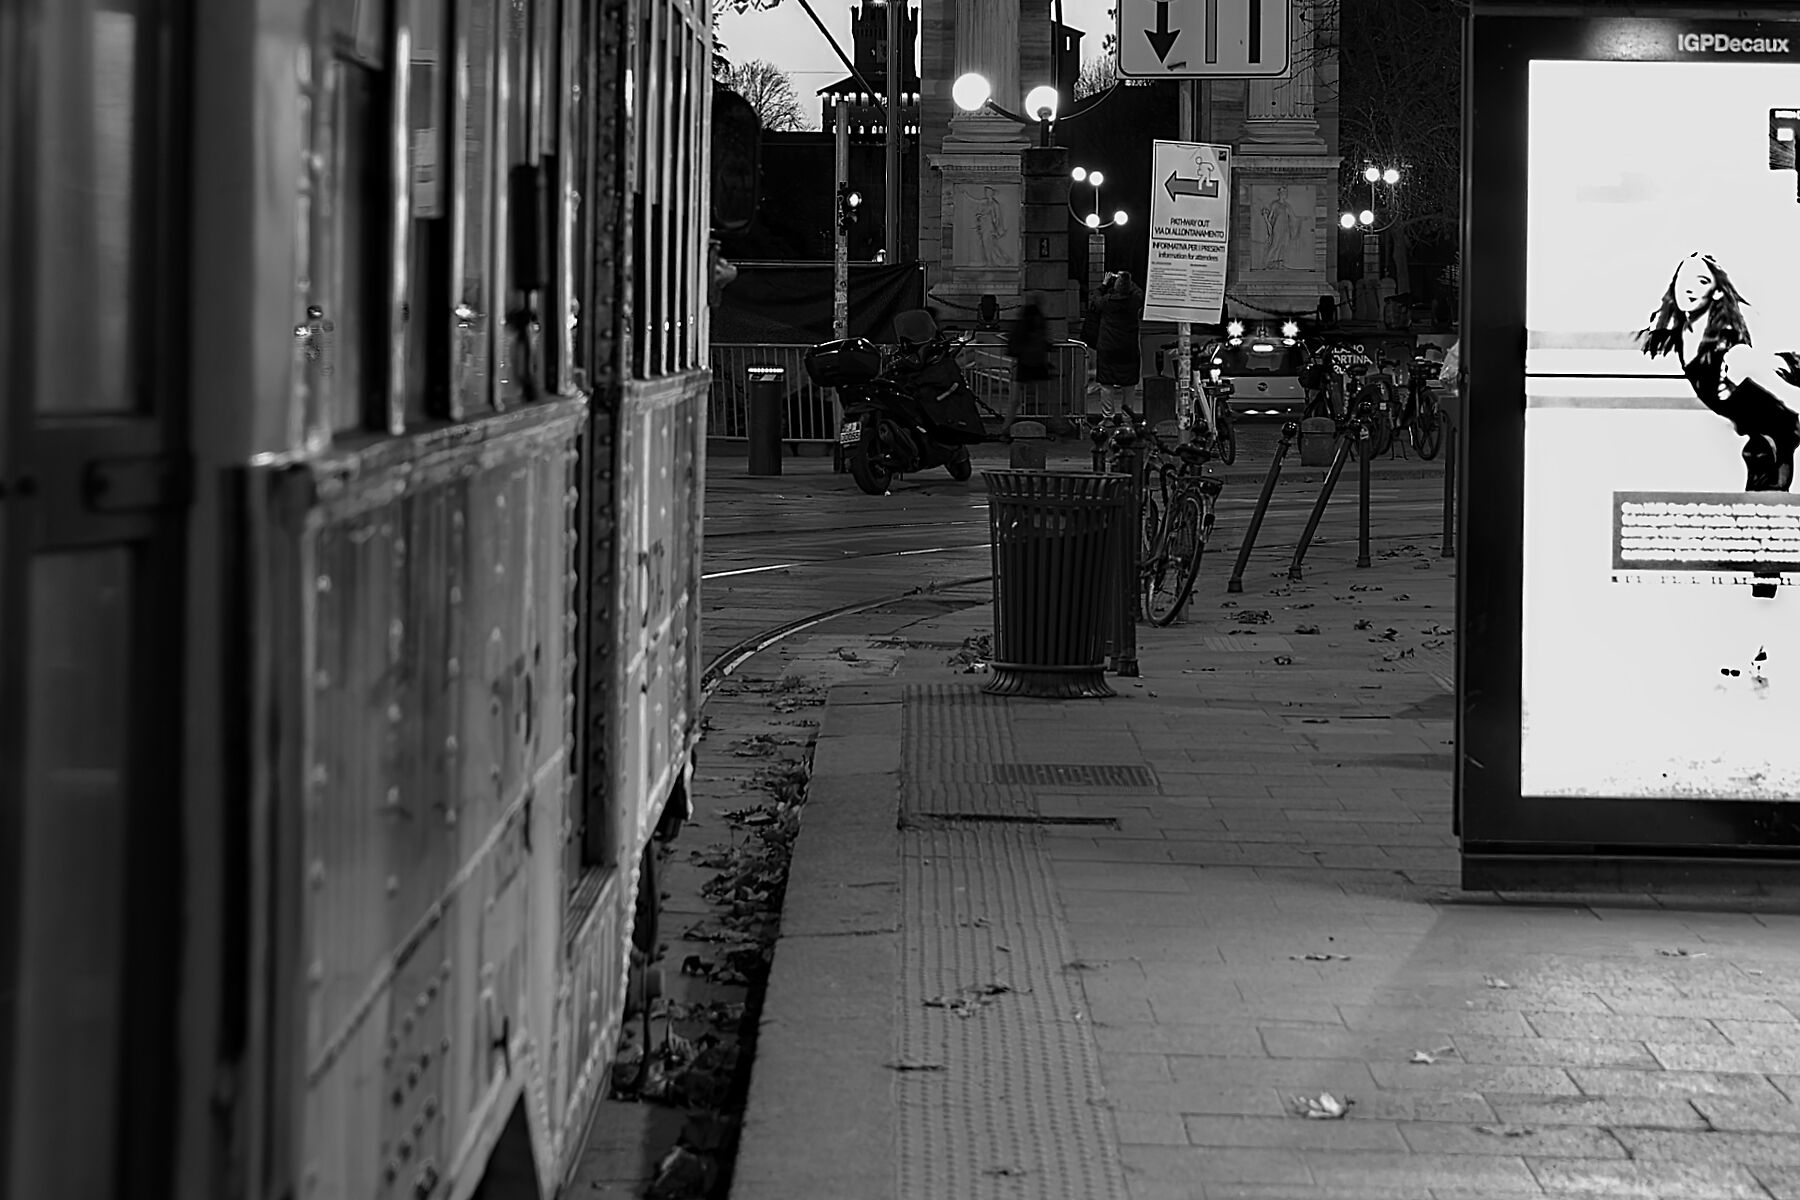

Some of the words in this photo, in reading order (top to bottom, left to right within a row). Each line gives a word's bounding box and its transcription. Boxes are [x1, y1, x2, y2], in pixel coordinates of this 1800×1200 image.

[1678, 33, 1789, 53] IGPDecaux
[1170, 217, 1197, 226] PATHWAY
[1197, 219, 1210, 227] OUT
[1154, 226, 1164, 235] VIA
[1172, 228, 1224, 238] ALLONTANAMENTO
